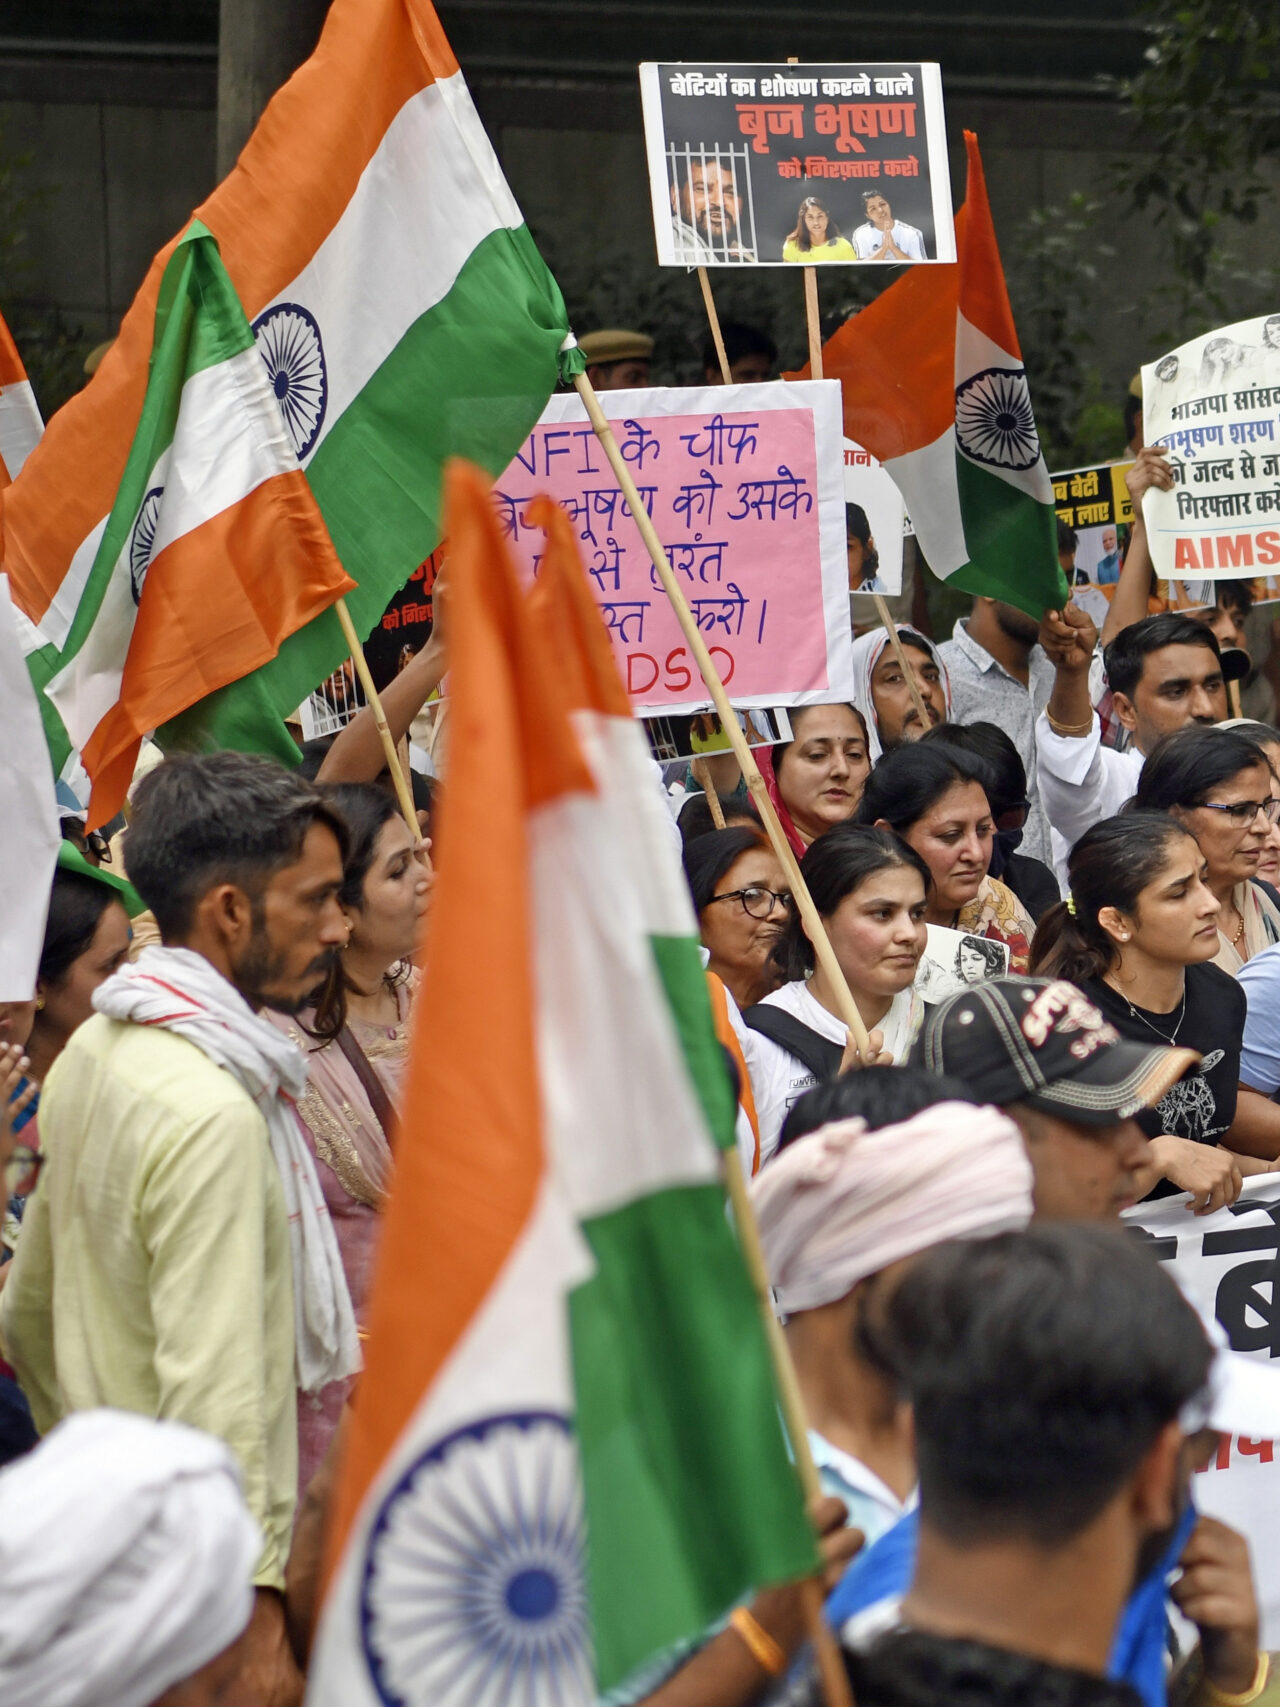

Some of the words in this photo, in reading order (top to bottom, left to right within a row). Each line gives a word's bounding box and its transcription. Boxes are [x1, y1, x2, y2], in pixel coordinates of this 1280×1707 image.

[670, 73, 727, 96] बेटियों
[730, 78, 756, 97] का
[760, 73, 818, 97] शोषण
[821, 73, 870, 96] करने
[874, 72, 914, 96] वाले
[736, 103, 804, 154] बृज
[814, 103, 917, 153] भूषण
[777, 156, 801, 178] को
[883, 154, 919, 177] करो
[1171, 393, 1228, 421] भाजपा
[1230, 416, 1274, 444] शरण
[622, 419, 660, 470] के
[1192, 457, 1234, 484] जल्द
[1240, 450, 1257, 479] से
[673, 469, 722, 529] को
[727, 465, 812, 521] उसके
[1070, 471, 1098, 498] बेटी
[1076, 501, 1110, 526] लाए
[590, 538, 626, 592] से
[382, 608, 399, 630] को
